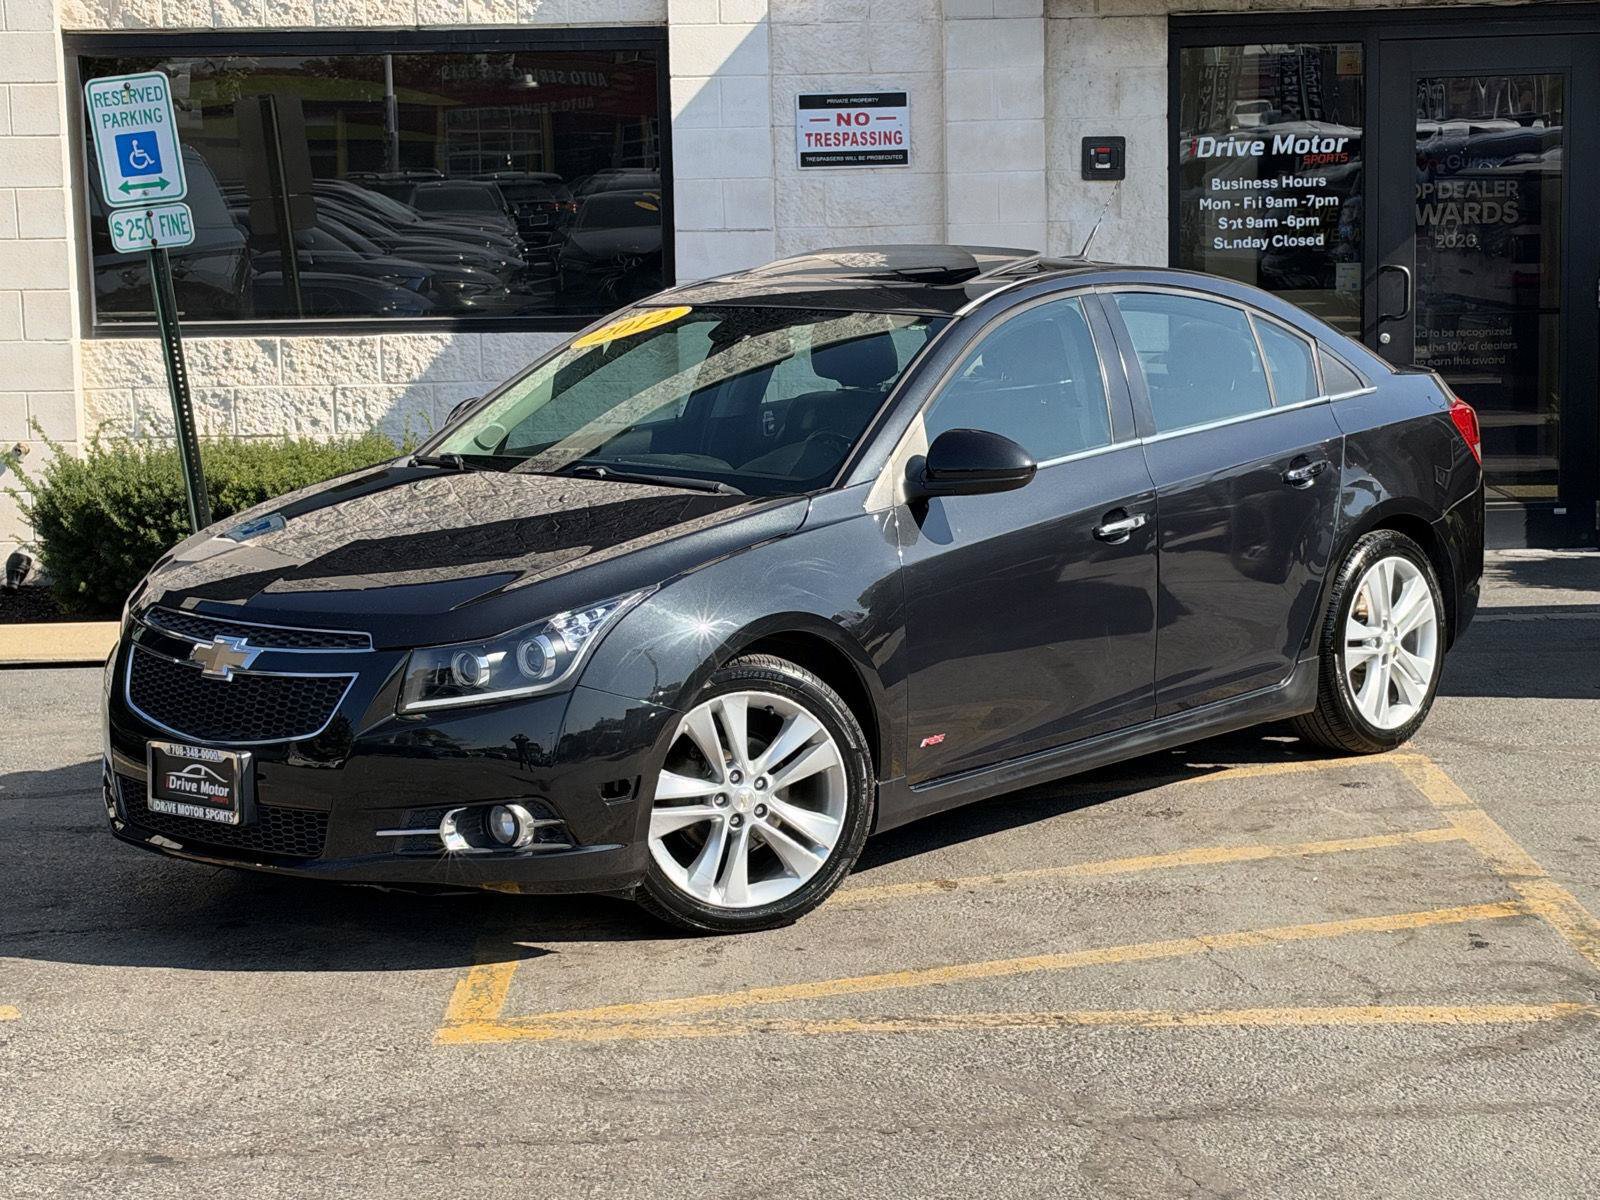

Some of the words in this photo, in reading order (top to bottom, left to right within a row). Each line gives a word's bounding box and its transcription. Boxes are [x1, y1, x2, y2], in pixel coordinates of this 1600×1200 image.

[93, 86, 163, 108] RESERVED
[102, 108, 163, 128] PARKING
[836, 112, 870, 127] NO
[805, 130, 903, 147] TRESPASSING
[1189, 135, 1265, 158] iDrive
[1272, 134, 1348, 155] Motor
[1303, 153, 1349, 165] SPORTS
[1211, 177, 1278, 191] Business
[1282, 175, 1327, 189] Hours
[1438, 180, 1519, 199] DEALER
[1199, 198, 1231, 210] Mon
[1265, 196, 1298, 208] 9am
[160, 212, 190, 237] FINE
[1246, 216, 1278, 229] 9am
[1272, 234, 1325, 247] Closed
[201, 780, 229, 797] Motor
[178, 803, 205, 818] MOTOR
[205, 808, 234, 823] SPORTS
